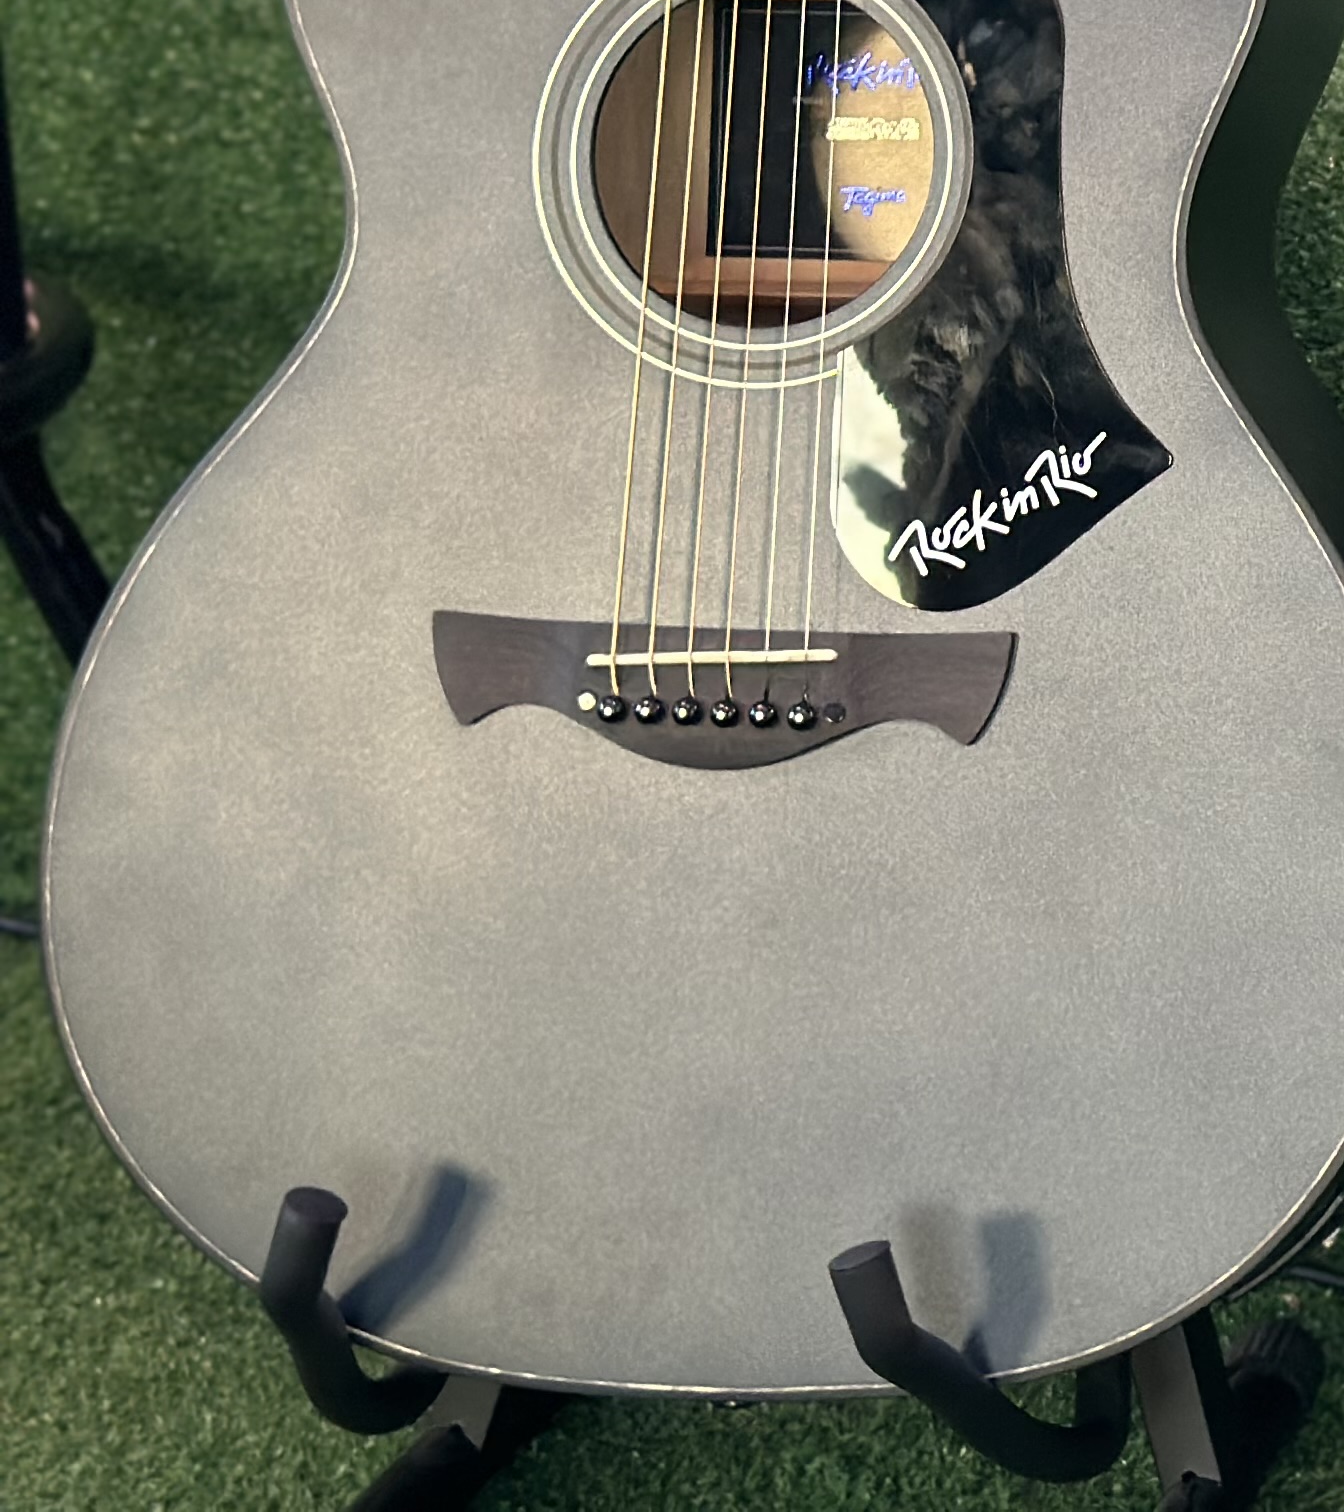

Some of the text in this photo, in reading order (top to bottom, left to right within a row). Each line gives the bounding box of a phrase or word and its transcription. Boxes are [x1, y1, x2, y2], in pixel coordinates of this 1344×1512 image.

[887, 431, 1107, 577] Rock in Rio
